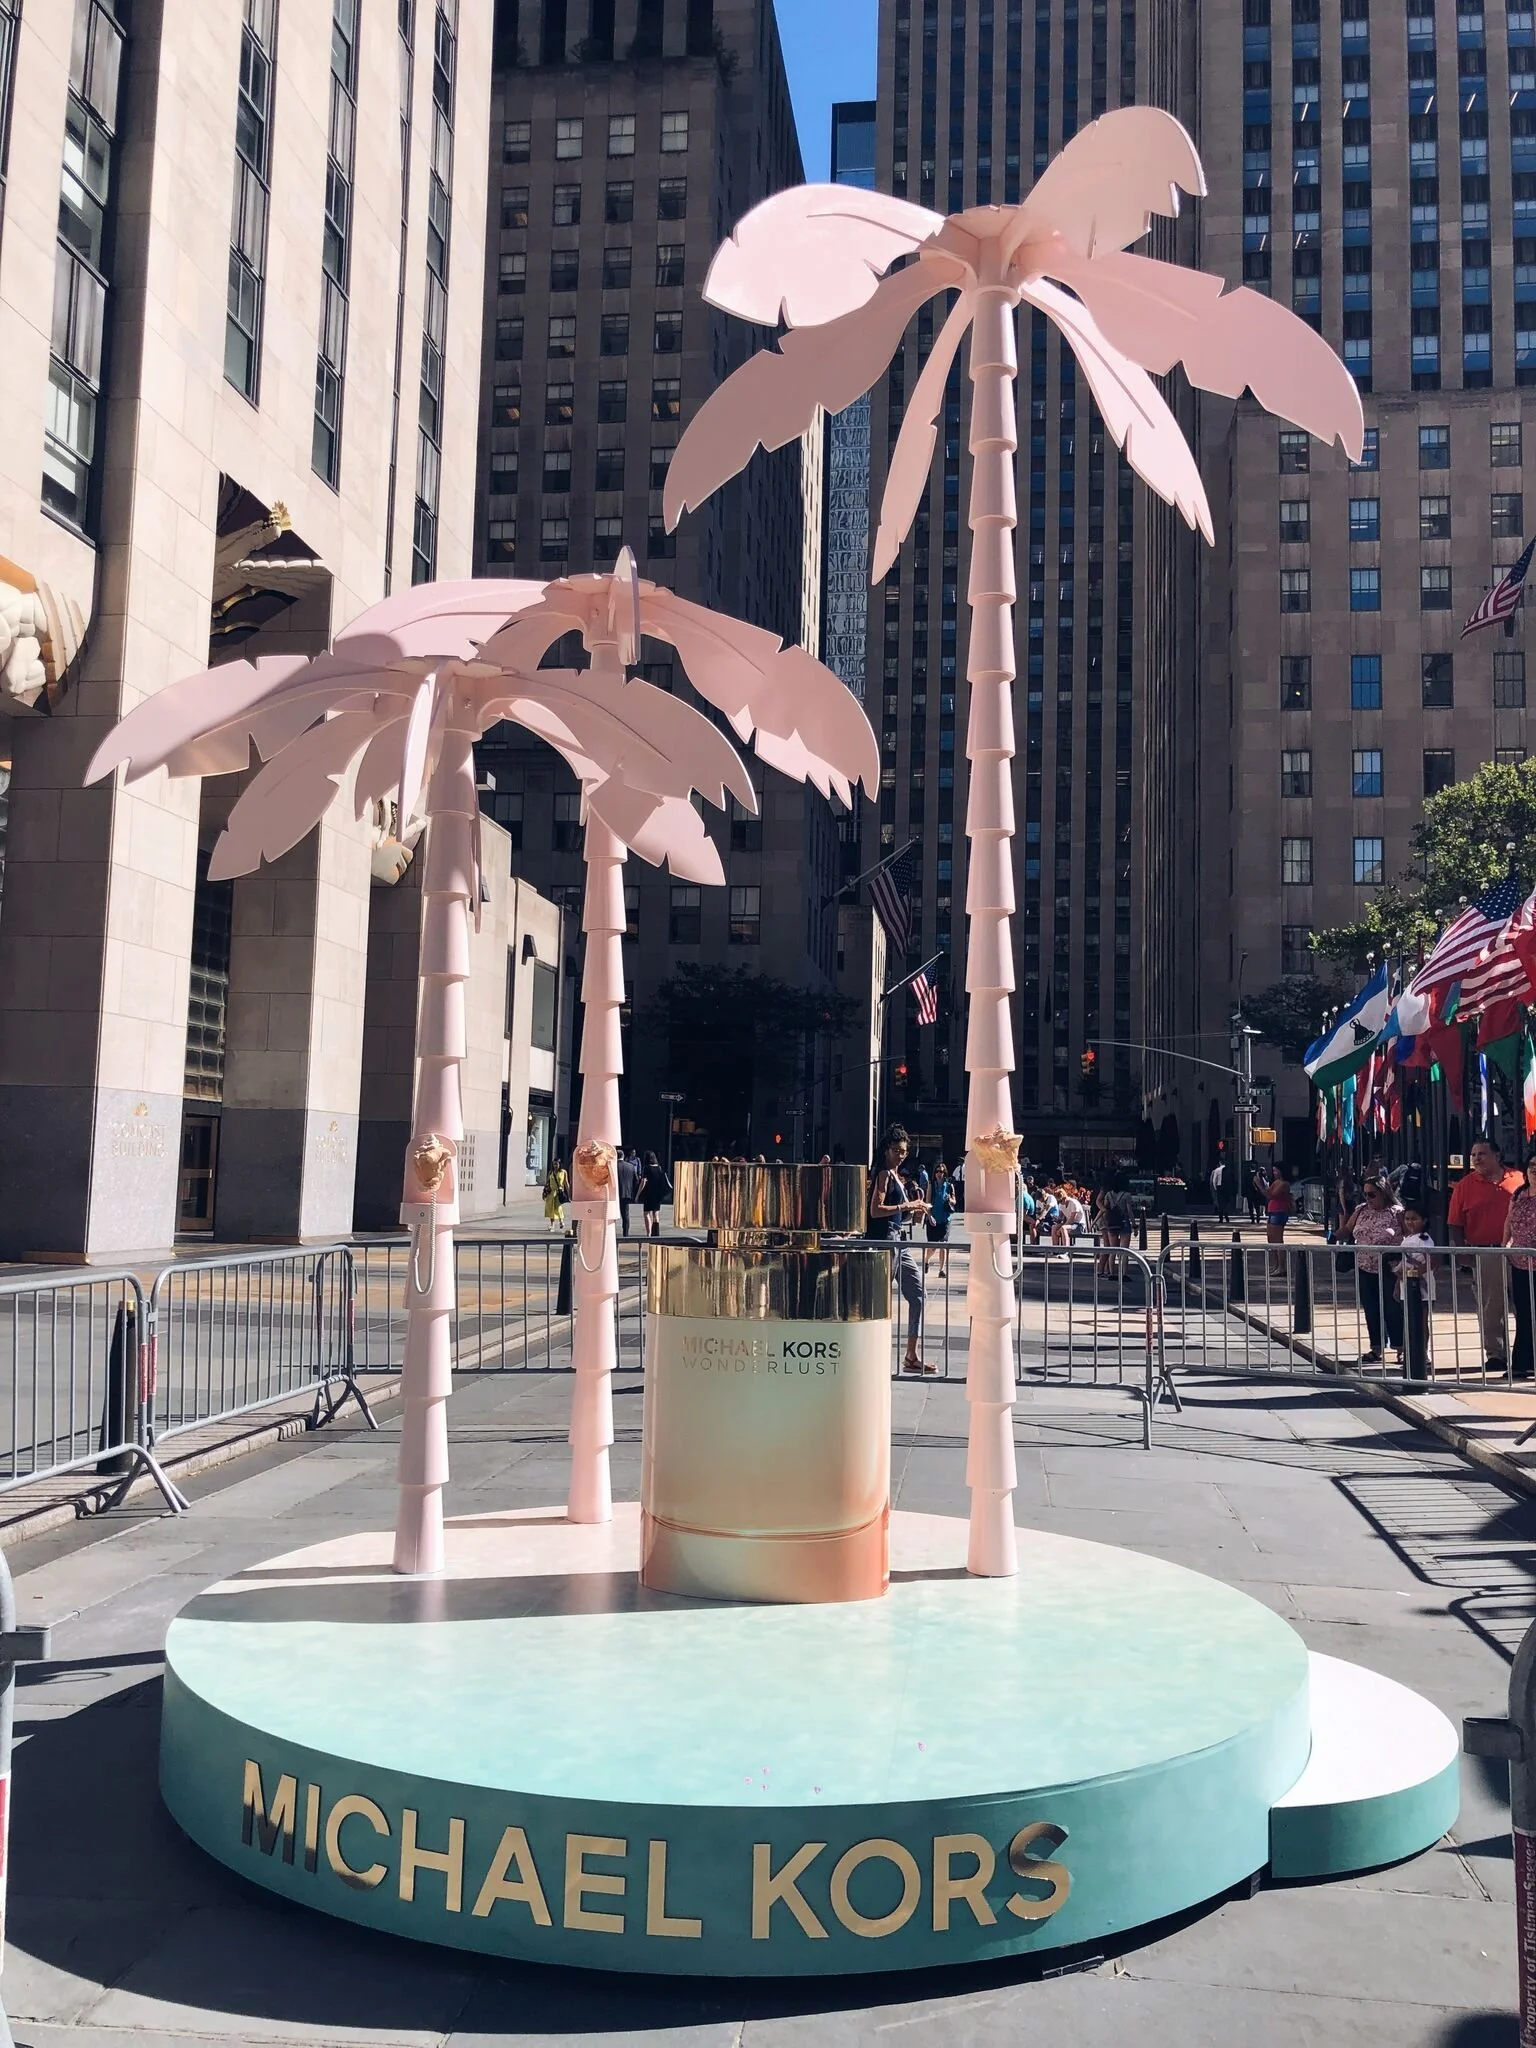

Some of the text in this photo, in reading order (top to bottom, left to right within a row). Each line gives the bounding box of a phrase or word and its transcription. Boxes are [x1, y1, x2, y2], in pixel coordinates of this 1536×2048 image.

[683, 1336, 841, 1359] MICHAEL KORS
[683, 1357, 840, 1375] WONDERLUST
[241, 1759, 1070, 1939] MICHAEL KORS
